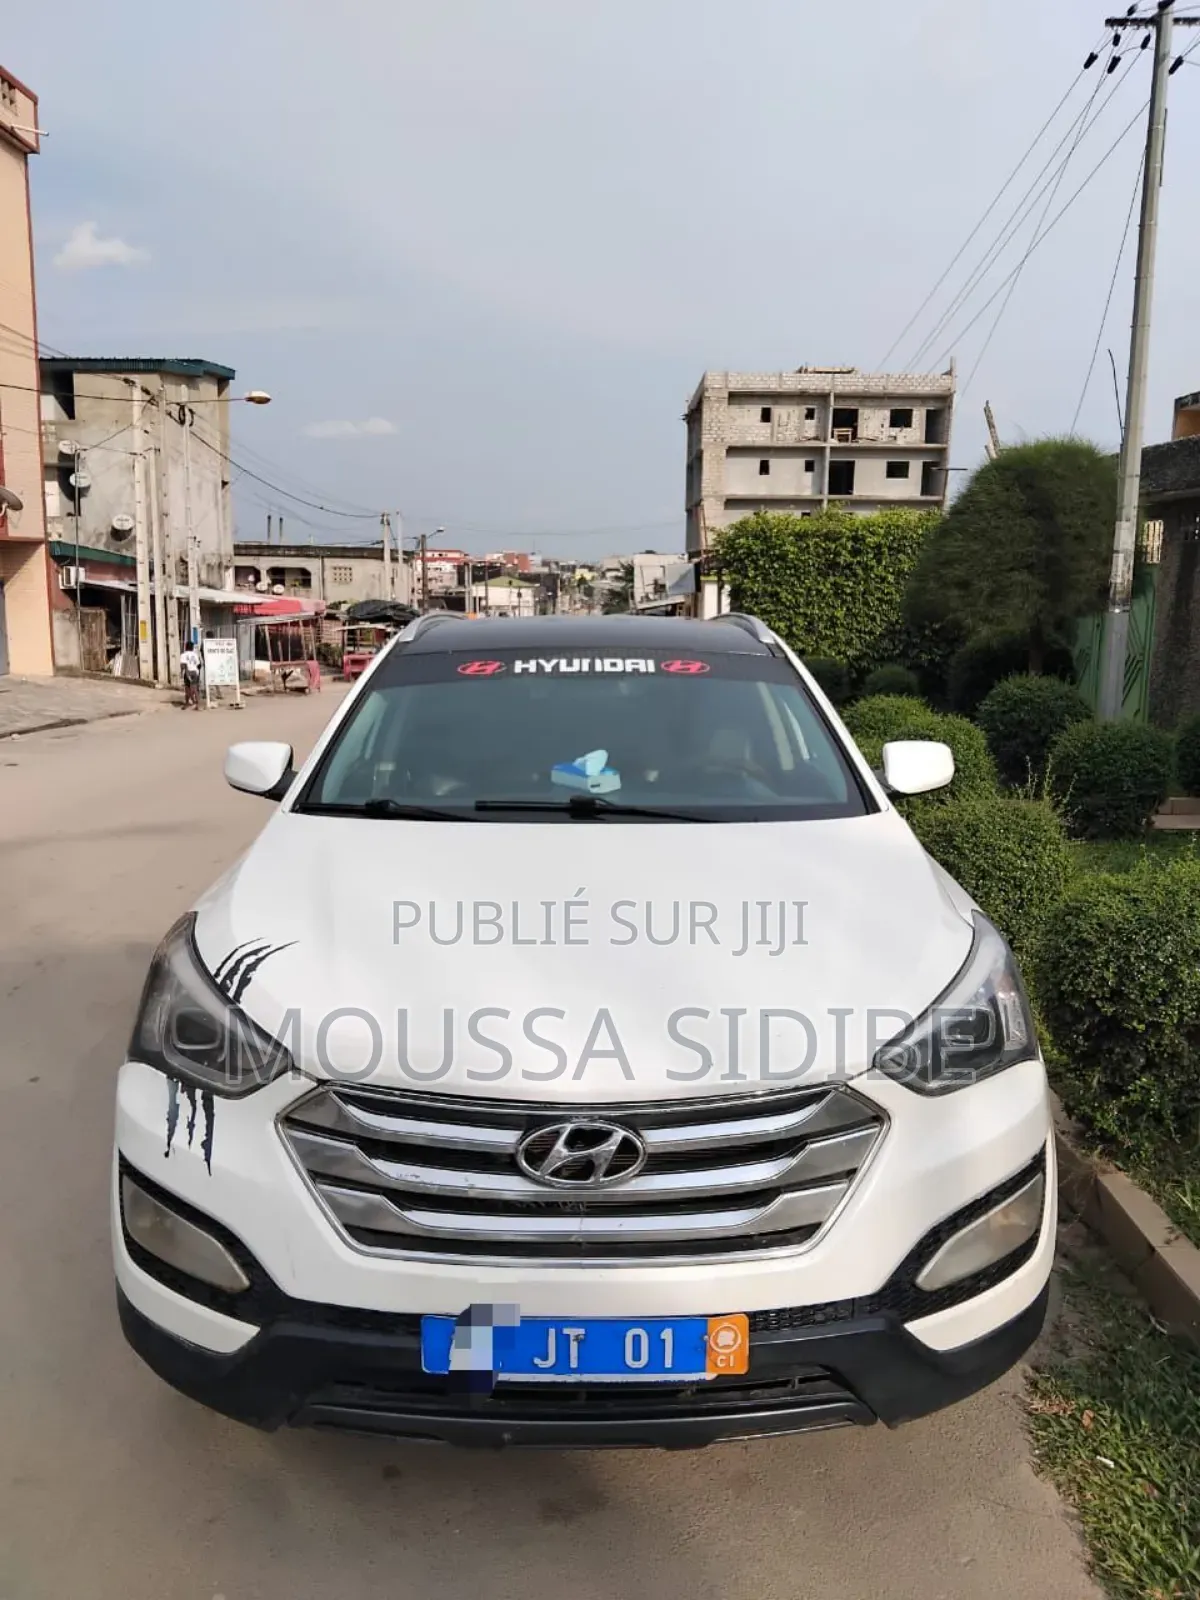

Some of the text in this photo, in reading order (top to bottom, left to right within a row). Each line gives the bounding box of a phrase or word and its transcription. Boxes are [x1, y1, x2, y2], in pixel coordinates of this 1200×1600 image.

[513, 657, 655, 674] HYUNDAI
[533, 1327, 586, 1369] JT
[624, 1328, 674, 1369] 01
